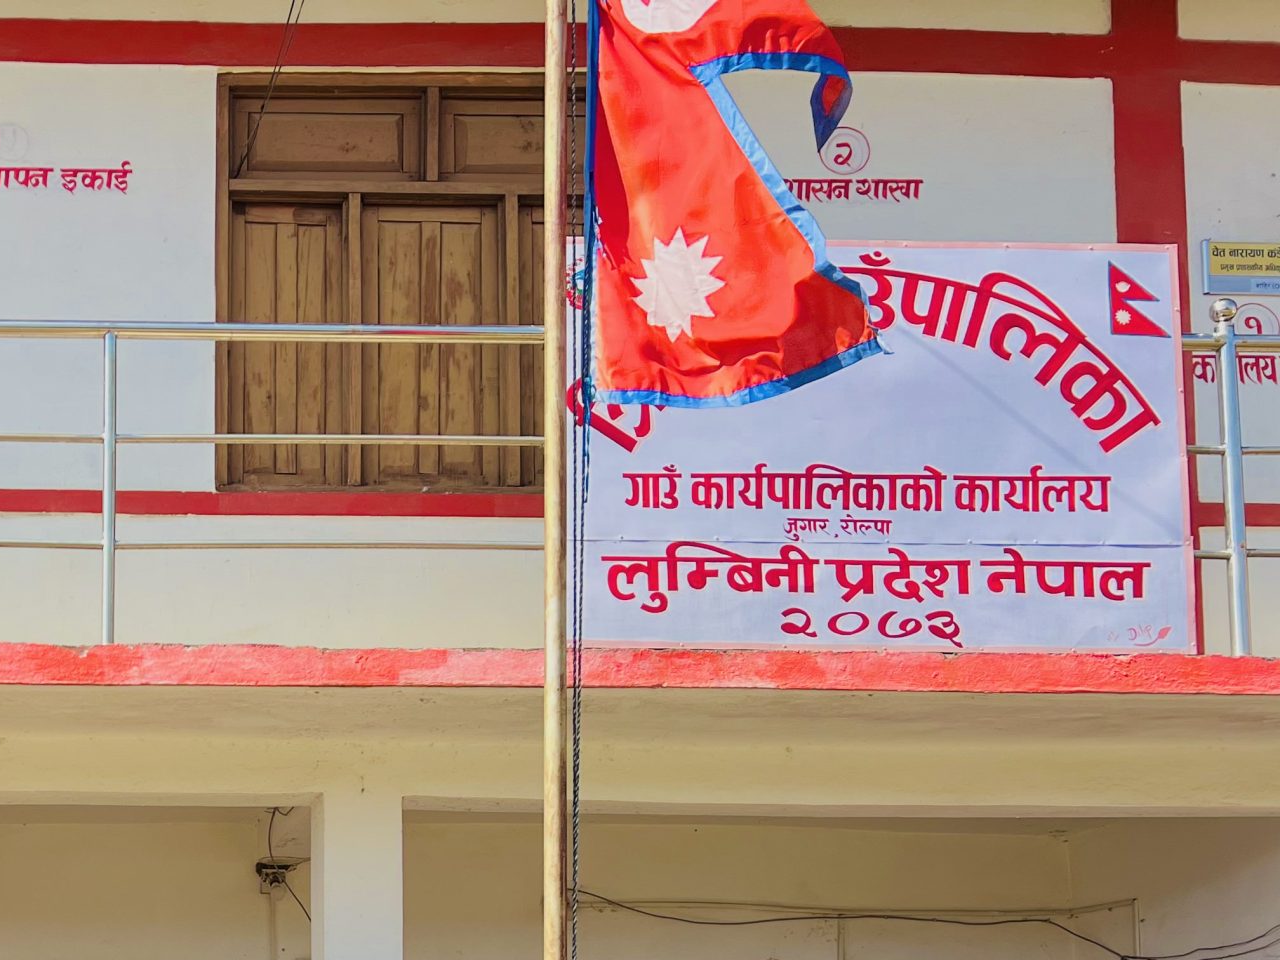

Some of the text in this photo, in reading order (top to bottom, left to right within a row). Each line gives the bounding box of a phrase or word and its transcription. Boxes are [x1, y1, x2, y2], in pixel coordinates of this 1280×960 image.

[833, 142, 853, 167] २
[59, 160, 133, 194] इकाई
[783, 178, 924, 203] शासन शाखा
[1228, 248, 1265, 258] नारायण
[838, 250, 1161, 454] उँपालिका
[622, 463, 1112, 513] गाउँ कार्यपालिकाको कार्यालय
[601, 541, 1152, 614] लुम्बिनी प्रदेश नेपाल
[780, 607, 964, 648] २०७३
